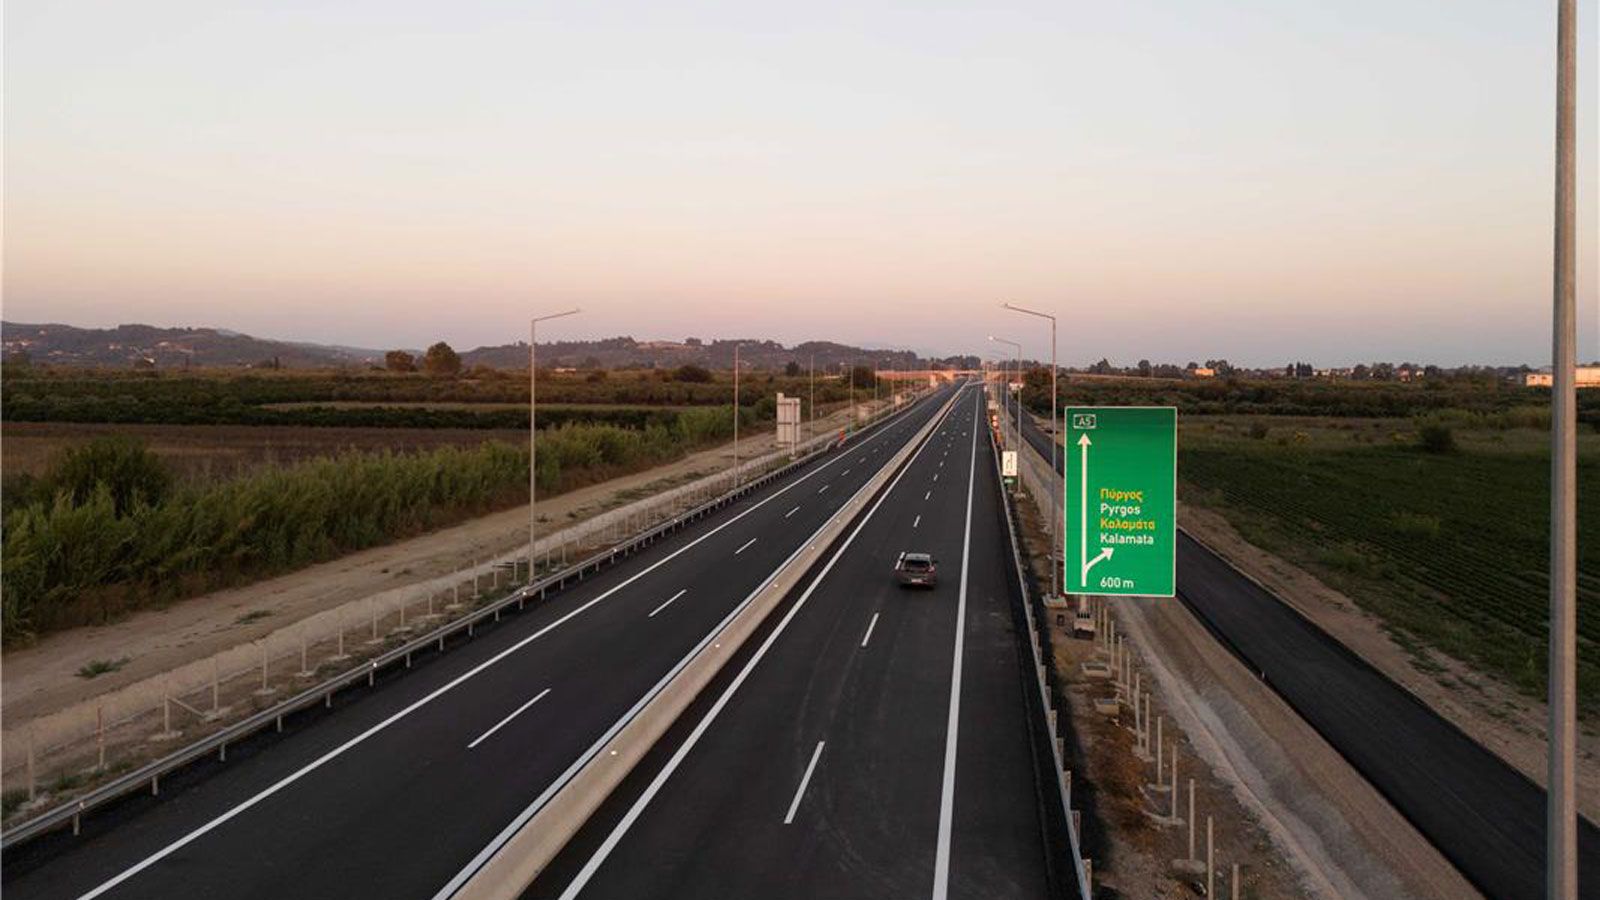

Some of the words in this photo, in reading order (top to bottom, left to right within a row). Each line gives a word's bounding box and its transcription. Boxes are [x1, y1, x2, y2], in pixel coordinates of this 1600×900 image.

[1079, 416, 1091, 427] A5
[1100, 488, 1143, 503] Πύργος
[1100, 503, 1141, 518] Pyrgos
[1100, 518, 1155, 532] Καλαμάτα
[1100, 533, 1154, 544] Kalamata
[1100, 577, 1121, 588] 600
[1122, 580, 1134, 588] m
